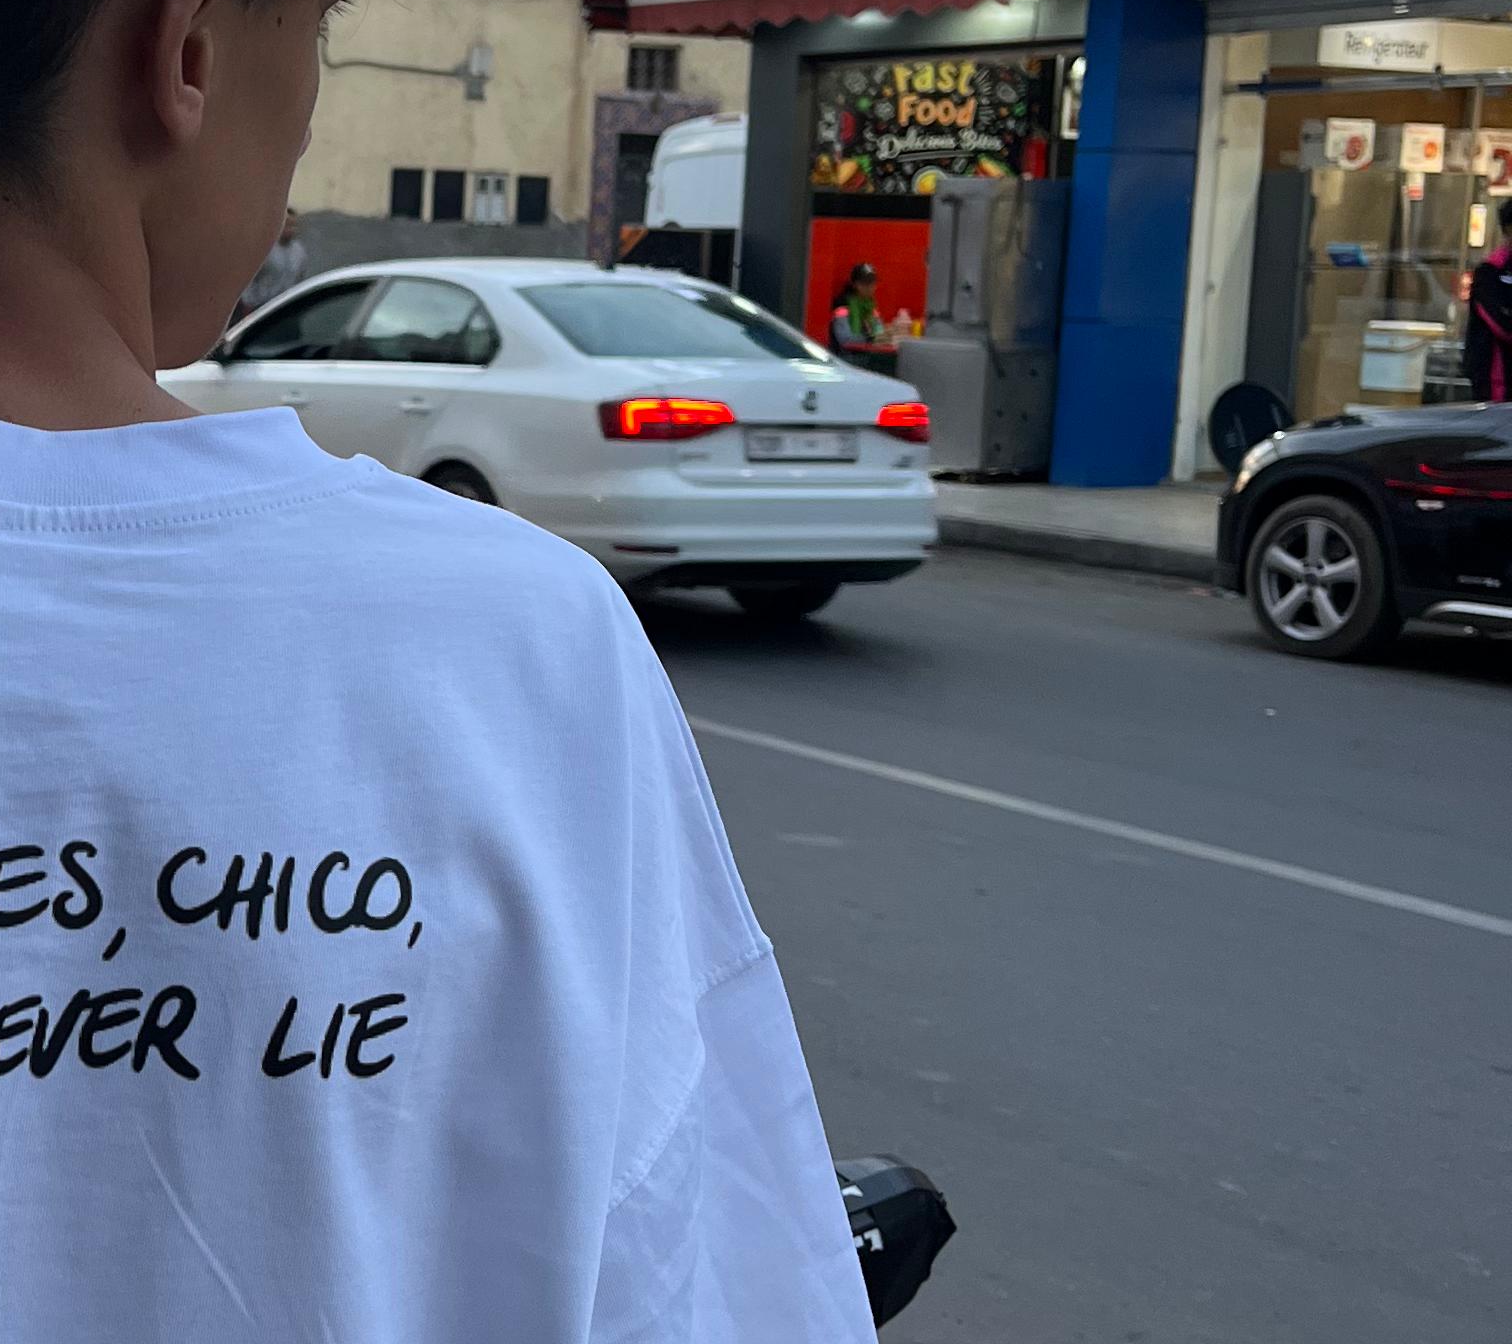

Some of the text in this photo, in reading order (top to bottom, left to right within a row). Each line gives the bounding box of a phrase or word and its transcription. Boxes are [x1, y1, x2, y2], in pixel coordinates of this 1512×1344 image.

[897, 94, 978, 129] Food
[156, 846, 423, 949] CHICO,
[261, 993, 408, 1080] LIE
